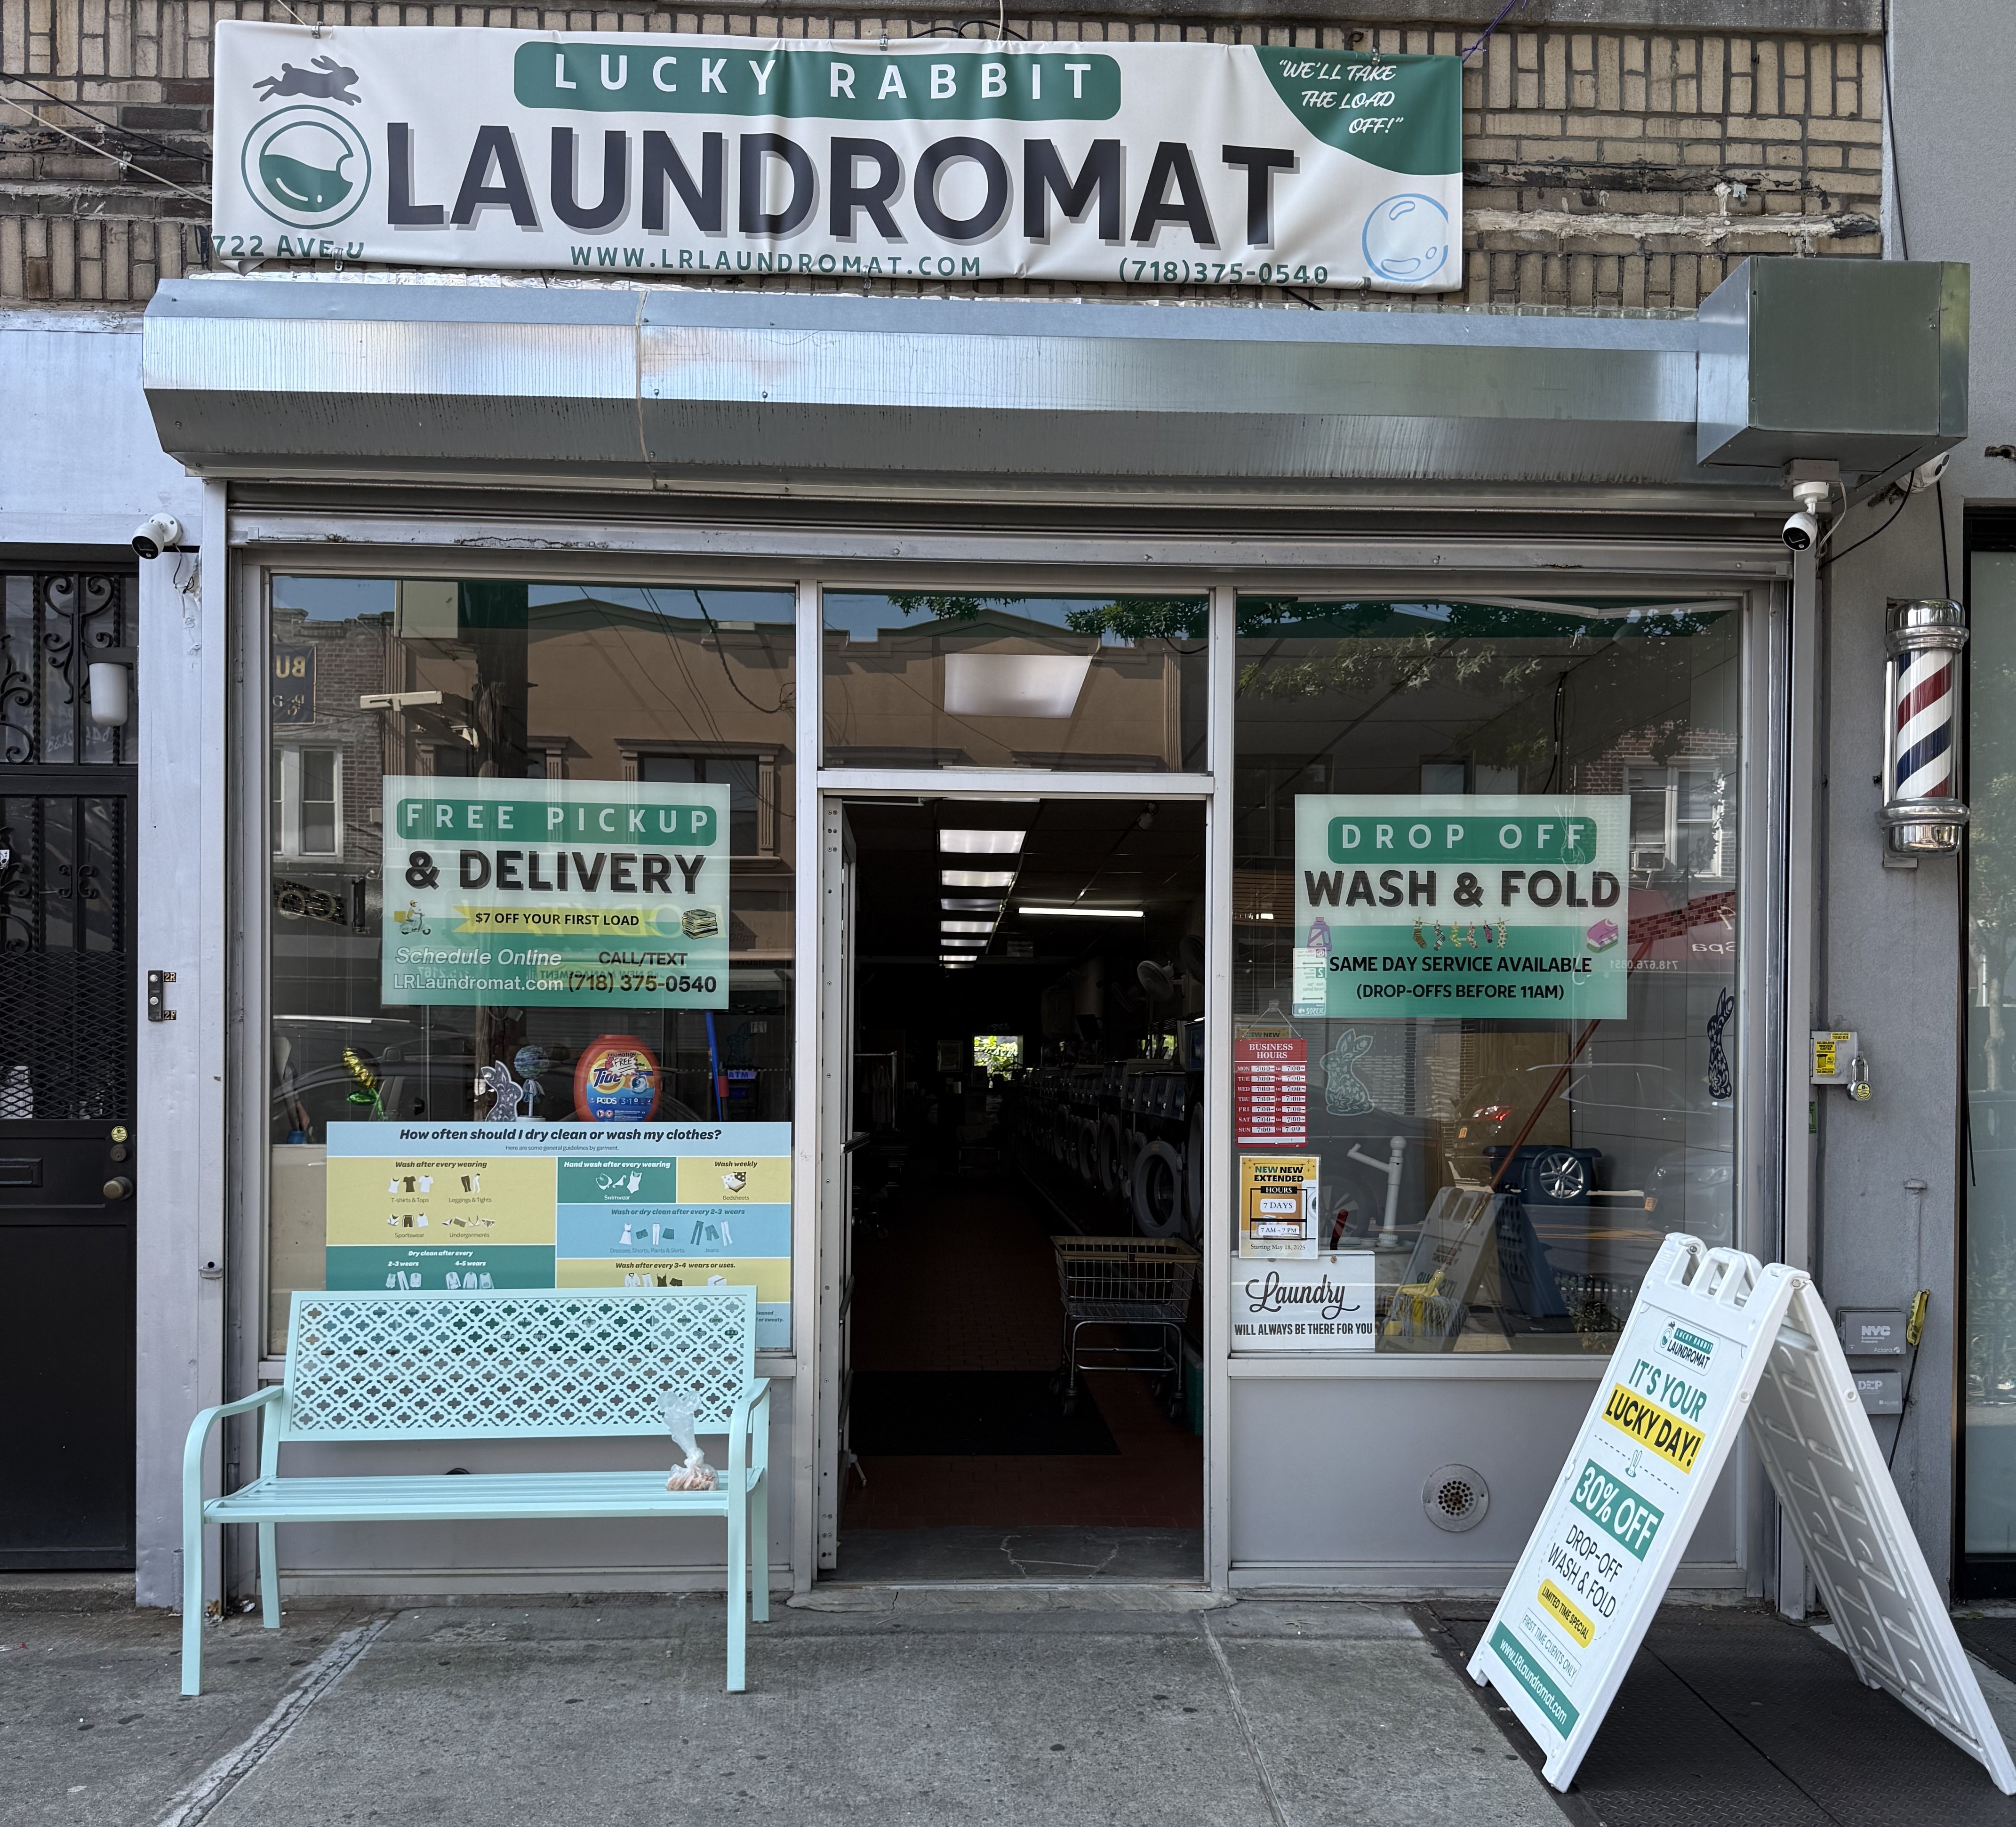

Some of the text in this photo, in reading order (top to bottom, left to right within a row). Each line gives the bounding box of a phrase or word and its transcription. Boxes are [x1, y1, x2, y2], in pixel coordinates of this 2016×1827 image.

[555, 53, 1091, 100] LUCKY RABBIT
[1347, 65, 1397, 81] TAKE
[1301, 90, 1395, 109] THE LOAD
[387, 122, 1300, 249] LAUNDROMAT
[277, 235, 334, 258] AVE
[346, 242, 364, 258] U
[571, 246, 980, 277] WWW.LRLAUNDROMAT.COM
[1120, 257, 1328, 284] (718)375-0540
[407, 804, 707, 833] FREE PICKUP
[1342, 824, 1584, 849] DROP OFF
[405, 849, 706, 894] & DELIVERY
[1304, 870, 1621, 908] WASH & FOLD
[475, 912, 639, 926] $7 OFF YOUR FIRST LOAD
[395, 947, 561, 966] Schedule Online
[599, 951, 688, 966] CALL/TEXT
[1330, 956, 1592, 973] SAME DAY SERVICE AVAILABLE
[165, 973, 176, 981] 2R
[394, 973, 563, 991] LRLaundromat.com
[568, 974, 717, 993] (718) 375-0540
[1357, 984, 1564, 1000] (DROP-OFFS BEFORE 11AM)
[614, 1056, 634, 1066] FREE
[400, 1129, 722, 1142] How often should I dry clean or wash my clothes?
[457, 1161, 487, 1169] wearing
[1245, 1271, 1360, 1320] Laundry
[1234, 1323, 1373, 1335] WILL ALWAYS BE THERE FOR YOU
[1676, 1330, 1692, 1342] LUCKY
[1861, 1326, 1890, 1336] NYC
[1667, 1339, 1710, 1369] LAUNDROMAT
[1628, 1359, 1707, 1422] IT'S YOUR
[1605, 1389, 1701, 1467] LUCKY DAY!
[1576, 1466, 1659, 1550] 30% OFF
[1566, 1524, 1622, 1582] DROP-OFF
[1548, 1542, 1616, 1618] WASH & FOLD
[1542, 1586, 1589, 1639] LIMITED TIME SPECIAL
[1522, 1615, 1577, 1678] FIRST TIME CLIENTS ONLY
[1500, 1639, 1567, 1724] www.LRLaundromat.com
